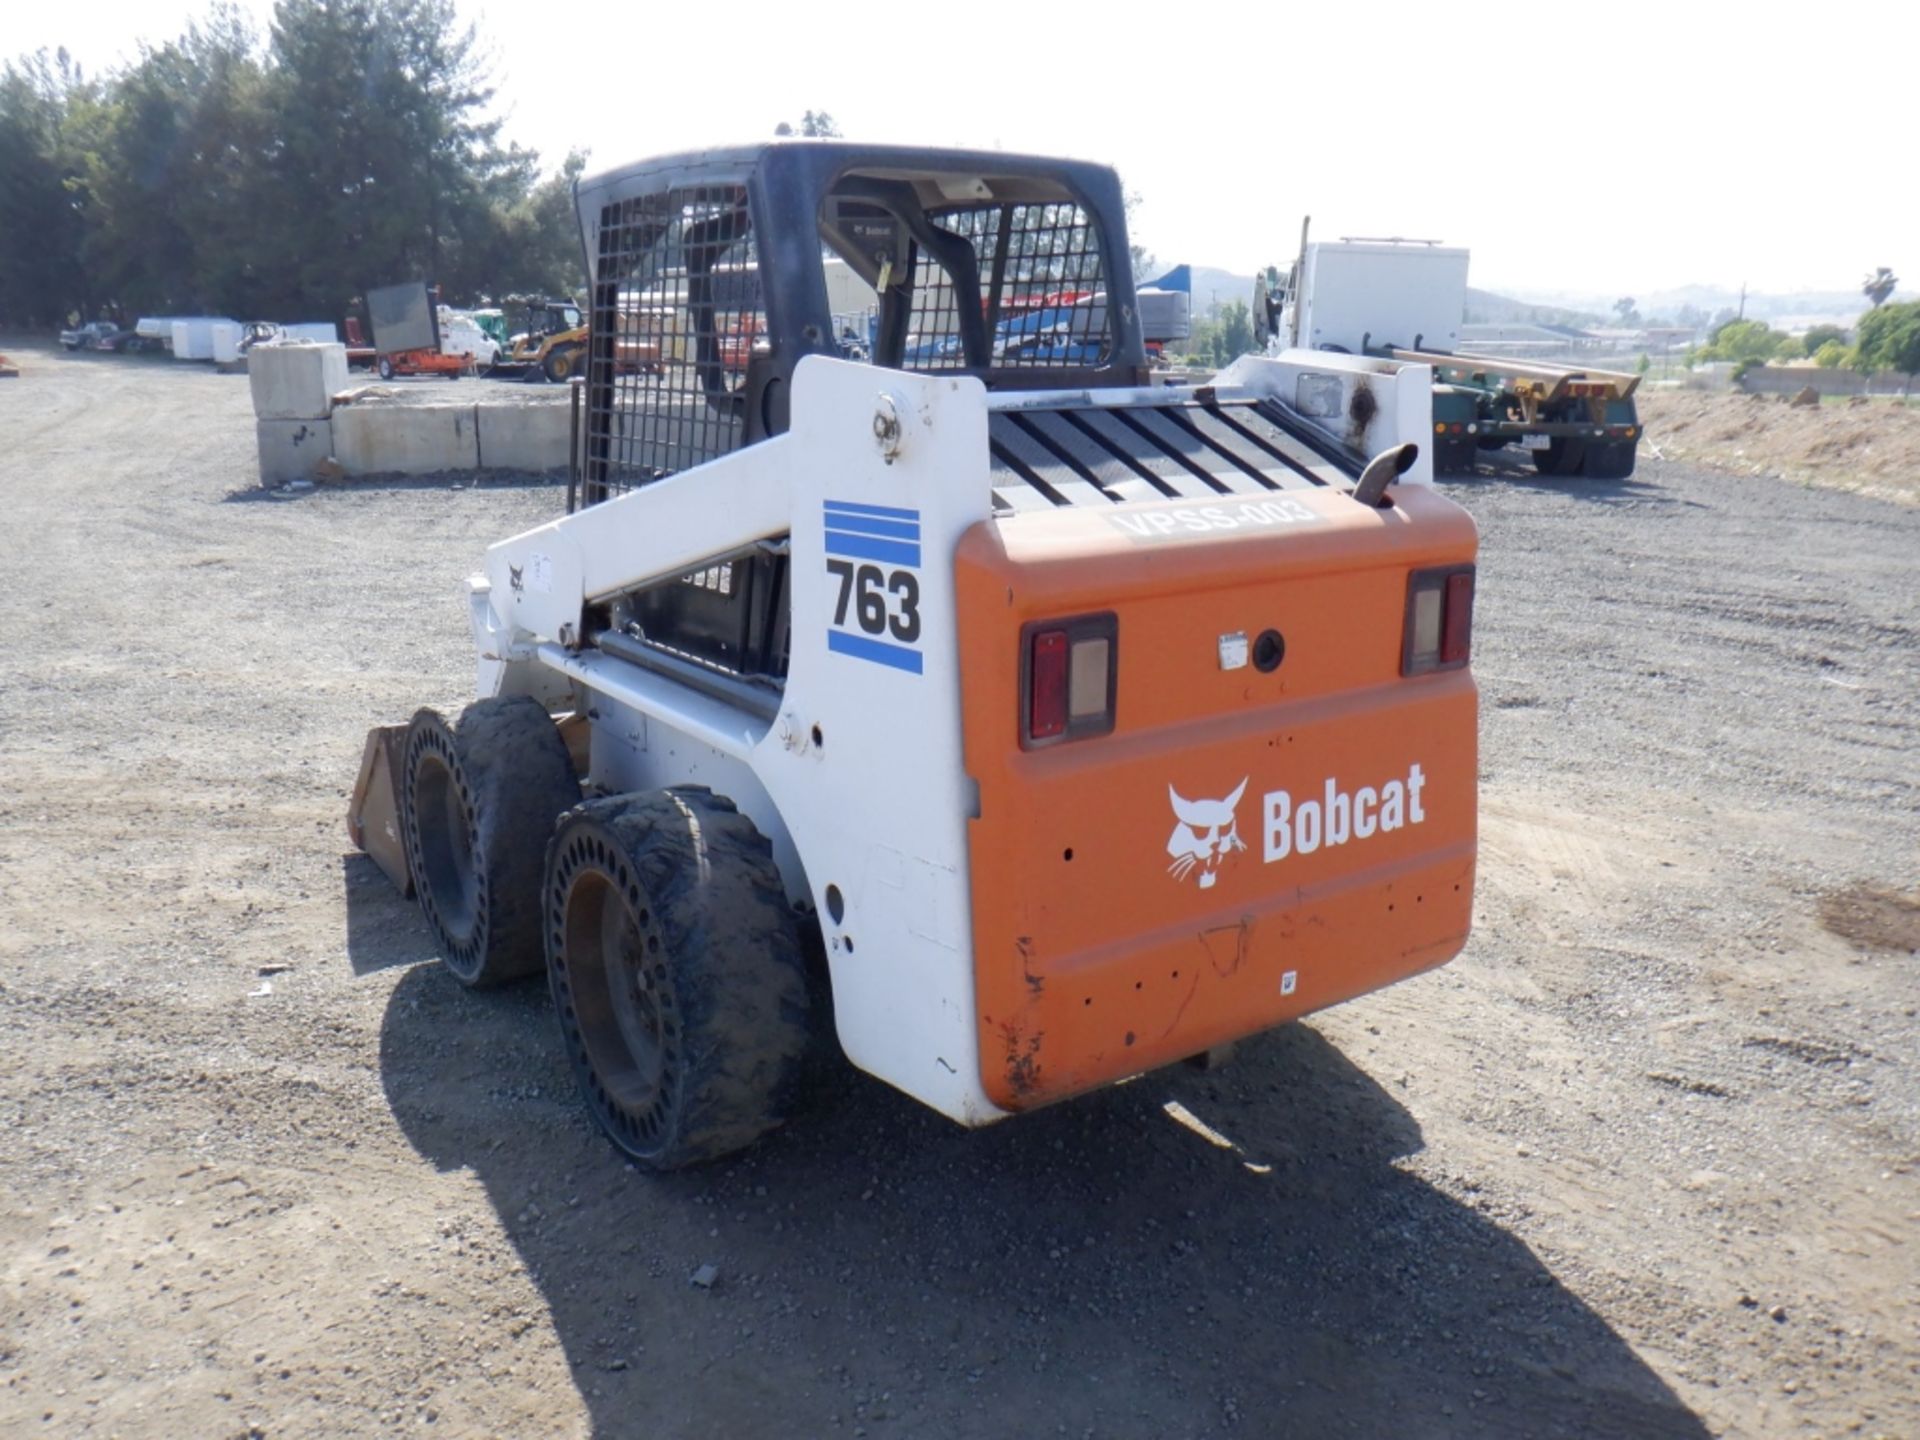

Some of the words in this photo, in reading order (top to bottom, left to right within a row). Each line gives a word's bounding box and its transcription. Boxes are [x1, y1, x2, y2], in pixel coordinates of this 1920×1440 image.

[1110, 499, 1317, 537] VPSS-003
[826, 558, 921, 643] 763
[1263, 763, 1426, 864] Bobcat
